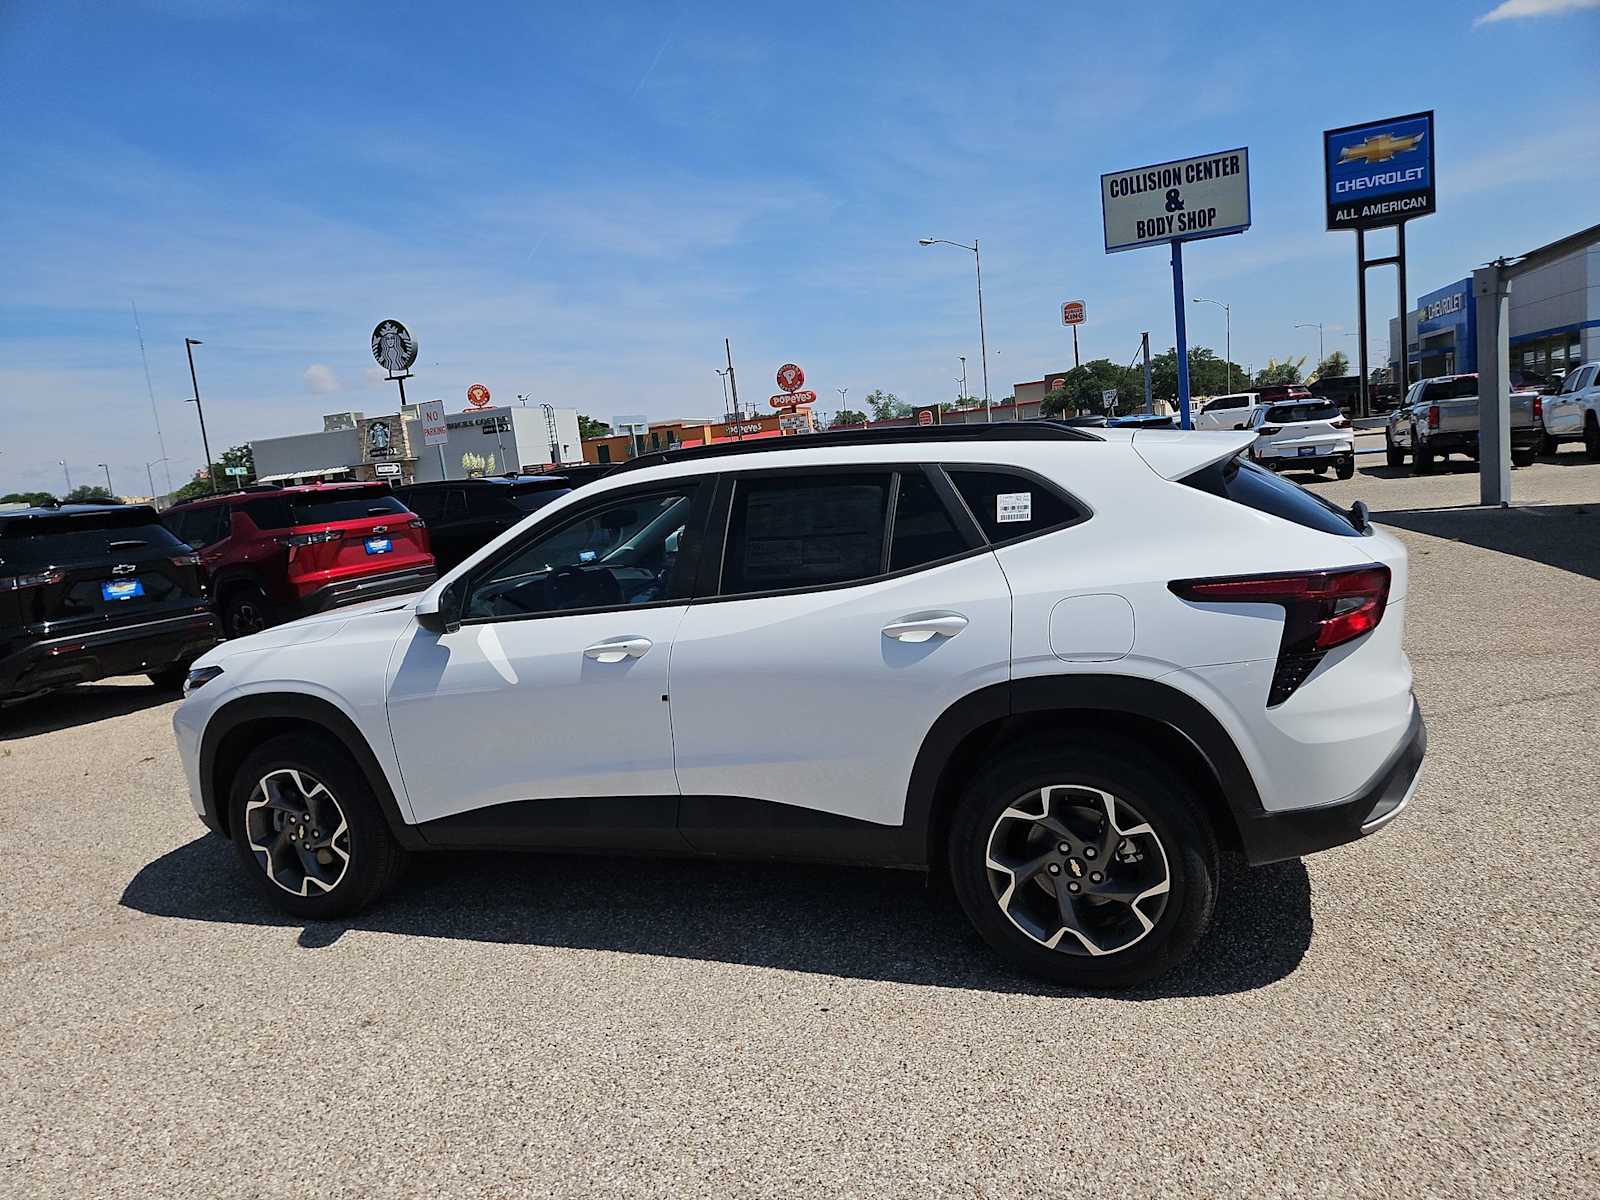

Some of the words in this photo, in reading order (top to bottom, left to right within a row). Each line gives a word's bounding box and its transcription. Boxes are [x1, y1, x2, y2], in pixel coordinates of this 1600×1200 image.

[1110, 167, 1182, 198] COLLISION
[1185, 156, 1240, 184] CENTER
[1335, 167, 1425, 193] CHEVROLET
[1165, 188, 1185, 212] &
[1335, 208, 1359, 222] ALL
[1361, 196, 1427, 217] AMERICAN
[1136, 215, 1174, 239] BODY
[1177, 207, 1216, 231] SHOP
[1064, 313, 1084, 321] KING
[1428, 293, 1462, 319] CHEVROLET
[426, 411, 439, 422] NO
